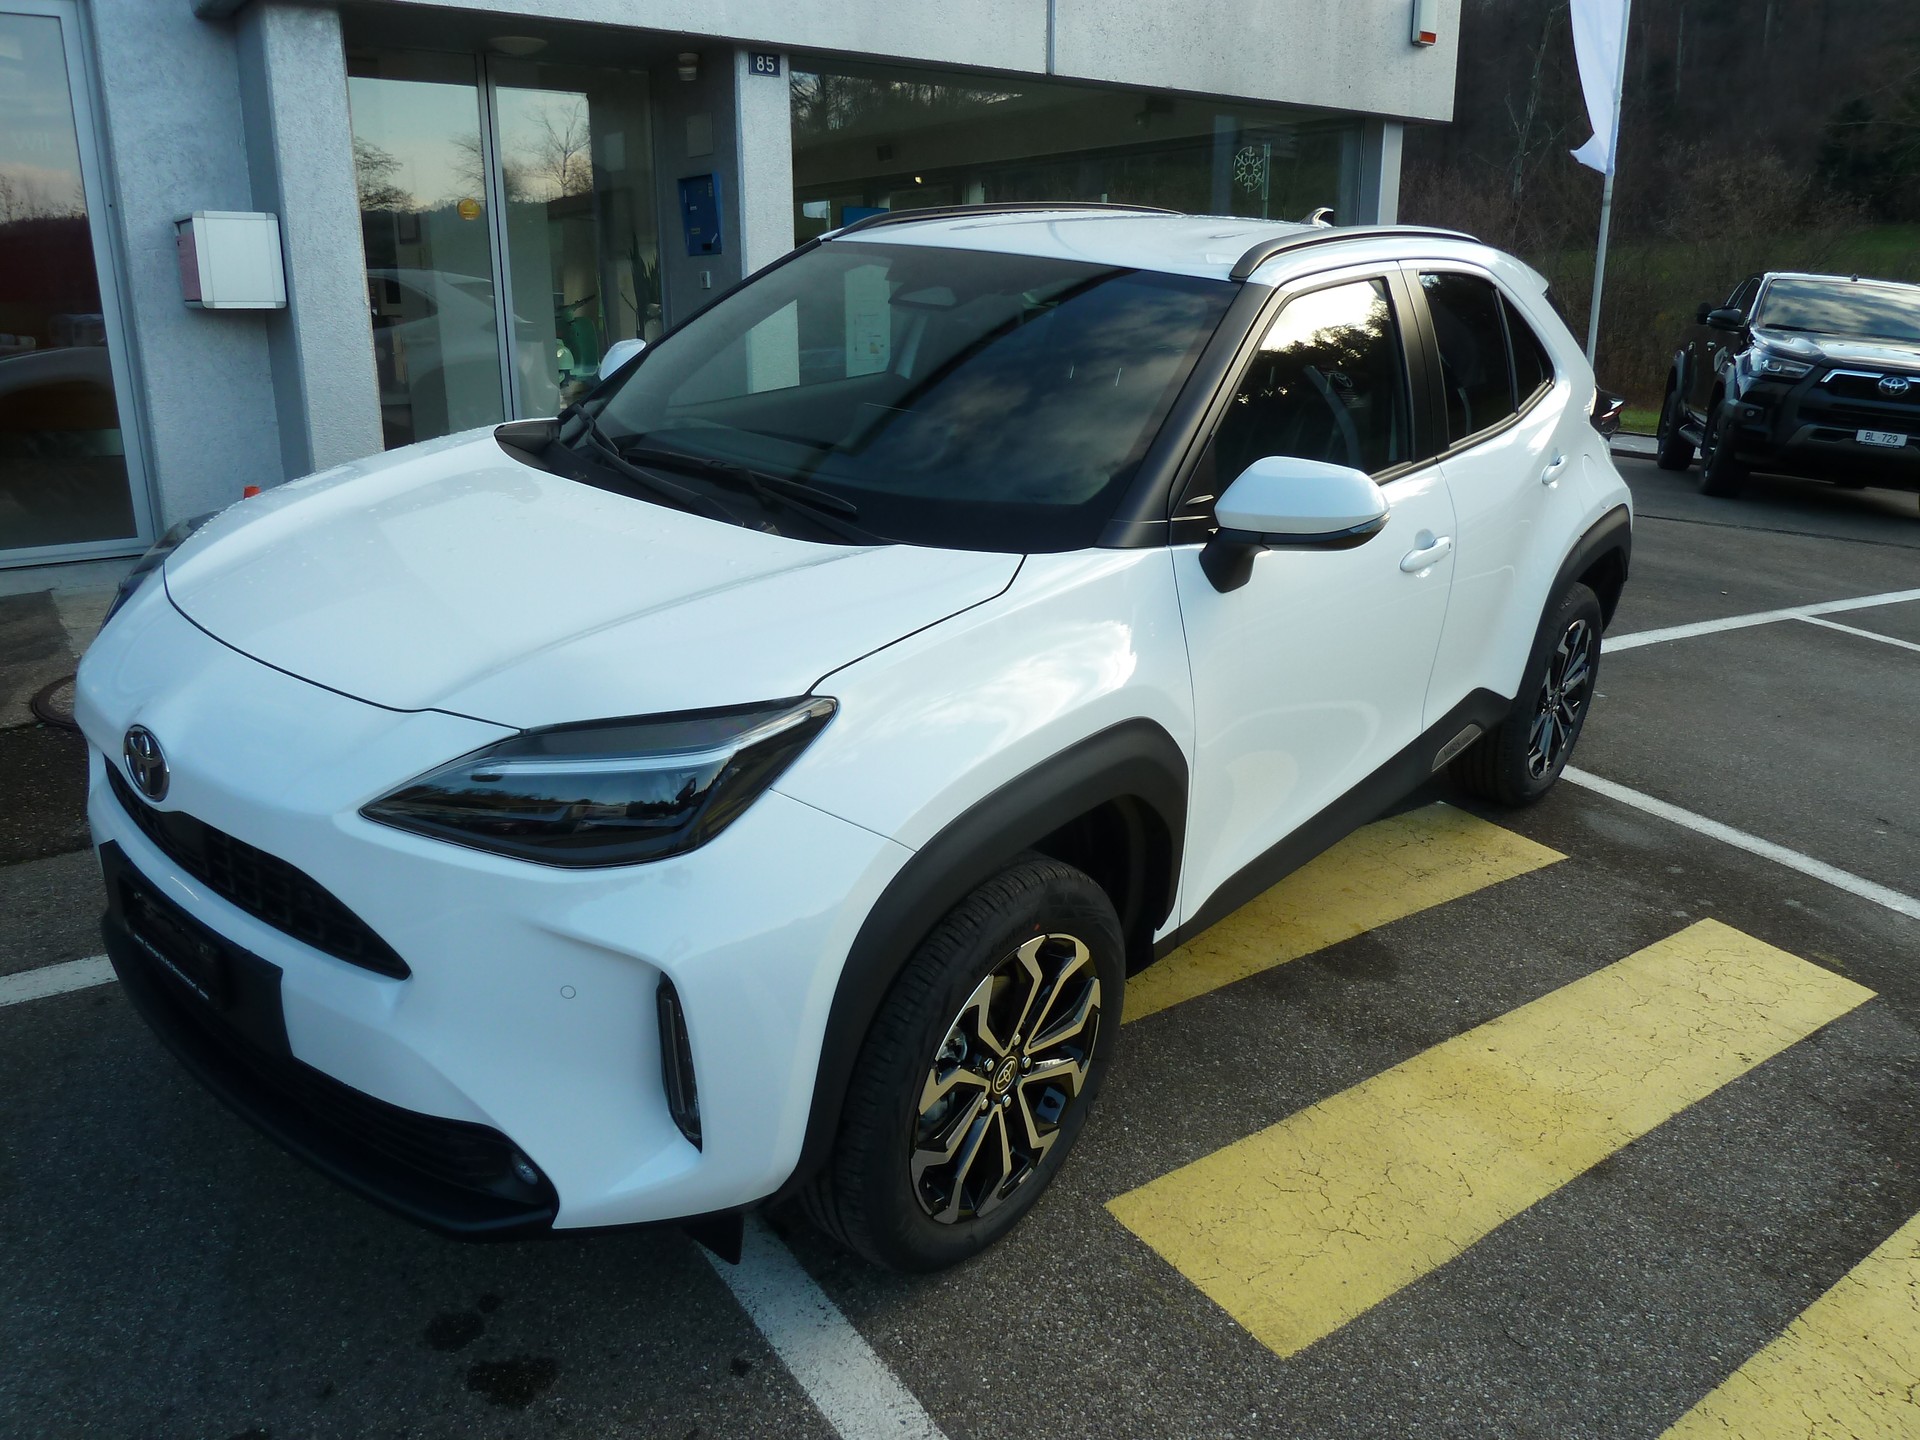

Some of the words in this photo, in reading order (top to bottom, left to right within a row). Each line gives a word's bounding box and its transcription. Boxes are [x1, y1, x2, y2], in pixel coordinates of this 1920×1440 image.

[757, 55, 775, 73] 85
[1864, 432, 1875, 441] BL
[1881, 433, 1898, 443] 729
